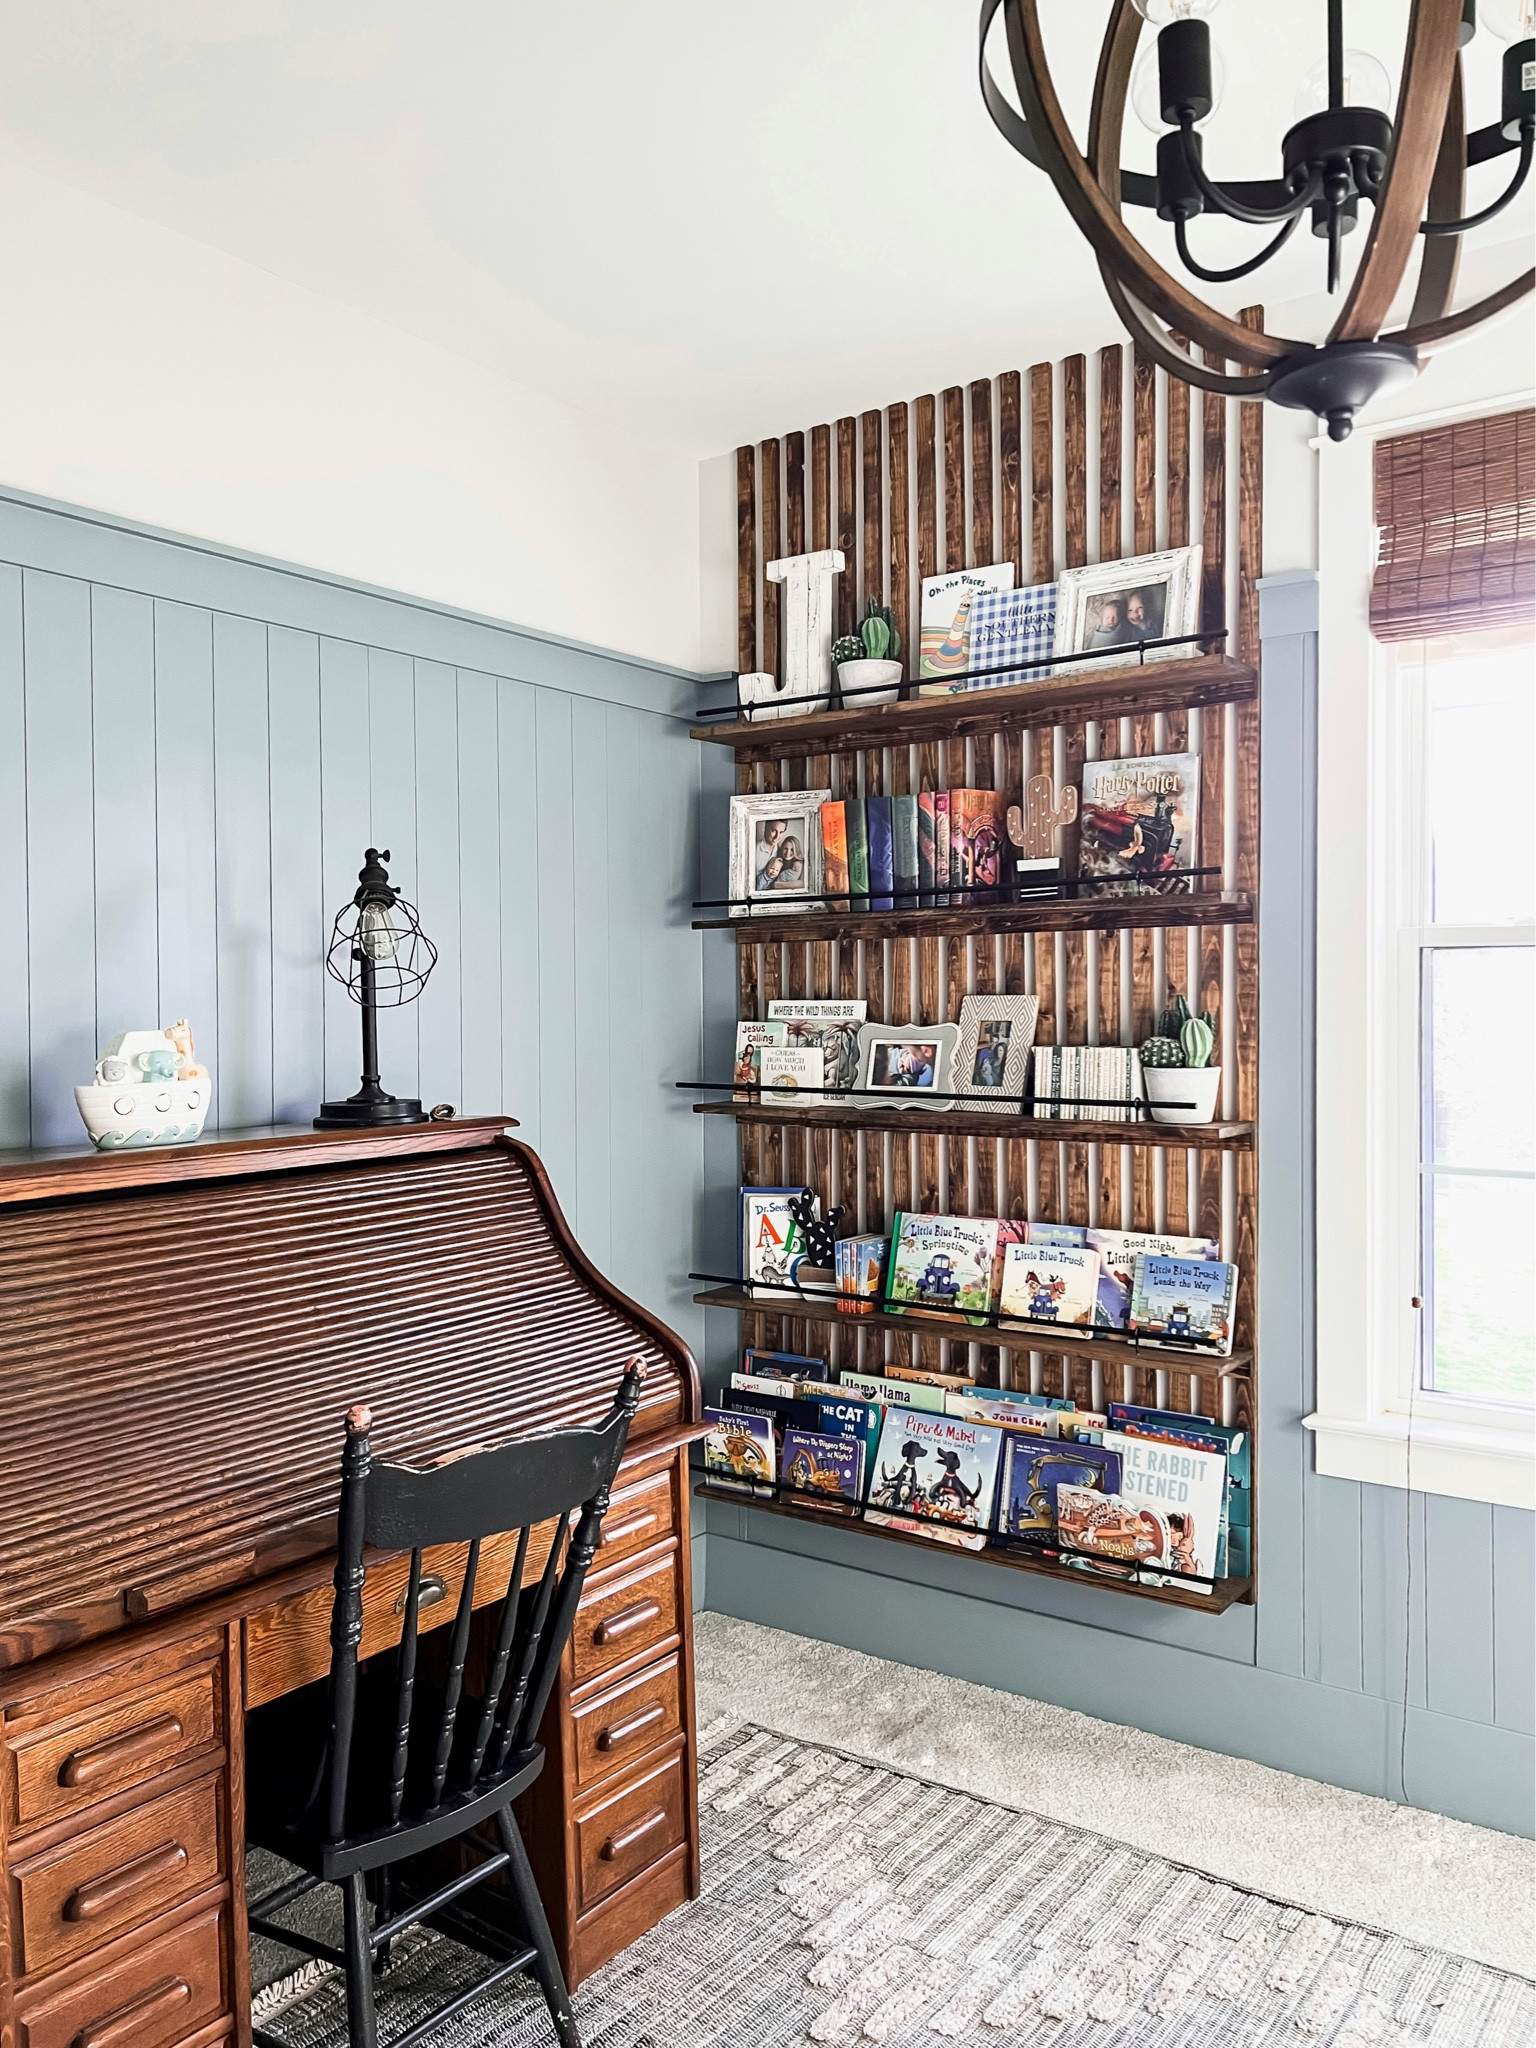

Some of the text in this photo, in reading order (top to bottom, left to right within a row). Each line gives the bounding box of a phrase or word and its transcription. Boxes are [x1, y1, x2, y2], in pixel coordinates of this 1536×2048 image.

[946, 580, 958, 589] the
[961, 575, 986, 588] Places
[1092, 771, 1180, 800] Harry Potter
[774, 1005, 854, 1016] WHERE THE WILD THINGS ARE
[742, 1024, 765, 1033] Jesus
[748, 1034, 774, 1045] Calling
[790, 1064, 806, 1072] YOU
[755, 1205, 769, 1215] Dr.
[911, 1223, 933, 1237] Little
[934, 1225, 953, 1237] Blue
[953, 1226, 985, 1246] Truck's
[922, 1239, 970, 1256] Springtime
[1123, 1238, 1146, 1249] Good
[1014, 1249, 1085, 1268] Little Blue Truck
[1107, 1251, 1135, 1265] Little
[1149, 1262, 1220, 1281] Little Blue Truck
[1153, 1276, 1212, 1293] Leads the Way
[880, 1385, 911, 1403] llama
[755, 1407, 777, 1418] NASHVILLE
[836, 1405, 864, 1422] CAT
[992, 1412, 1019, 1424] JOHN
[1021, 1416, 1048, 1429] CENA
[719, 1415, 750, 1427] Baby's First
[844, 1423, 855, 1432] IN
[718, 1422, 753, 1438] Bible
[905, 1415, 935, 1435] Piper
[945, 1425, 977, 1444] Mabel
[792, 1435, 854, 1453] Where Do Diggers Sleep
[826, 1451, 853, 1462] at Night?
[1148, 1450, 1208, 1482] RABBIT
[1099, 1539, 1135, 1556] Noah's
